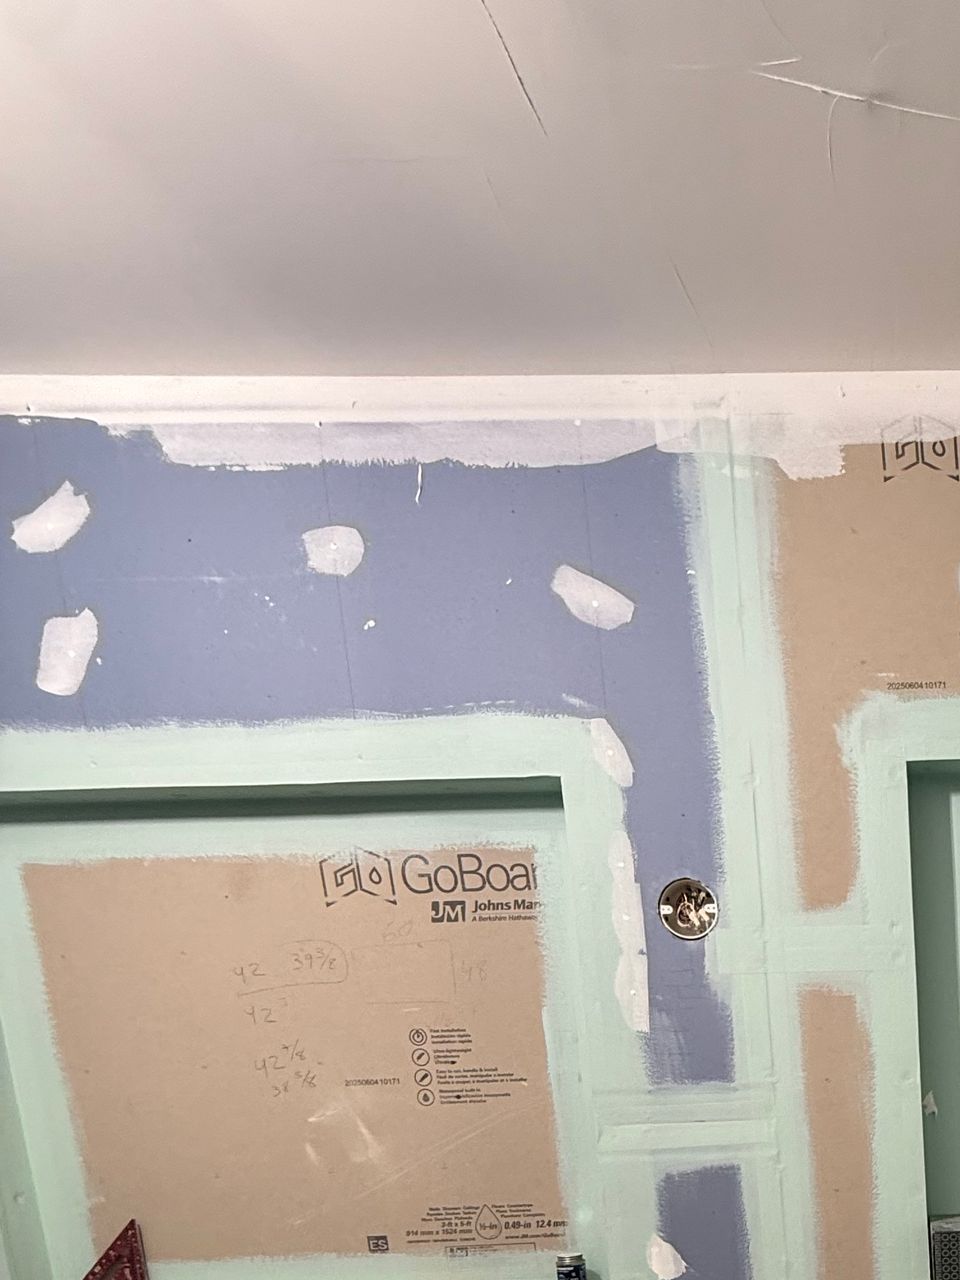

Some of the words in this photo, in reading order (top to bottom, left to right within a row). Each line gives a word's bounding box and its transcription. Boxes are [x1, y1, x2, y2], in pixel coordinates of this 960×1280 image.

[401, 853, 537, 894] GoBoar
[431, 900, 466, 923] JM
[472, 899, 511, 913] Johns
[504, 1220, 532, 1230] 0.49-in
[536, 1220, 552, 1228] 12.4
[369, 1238, 389, 1251] ES
